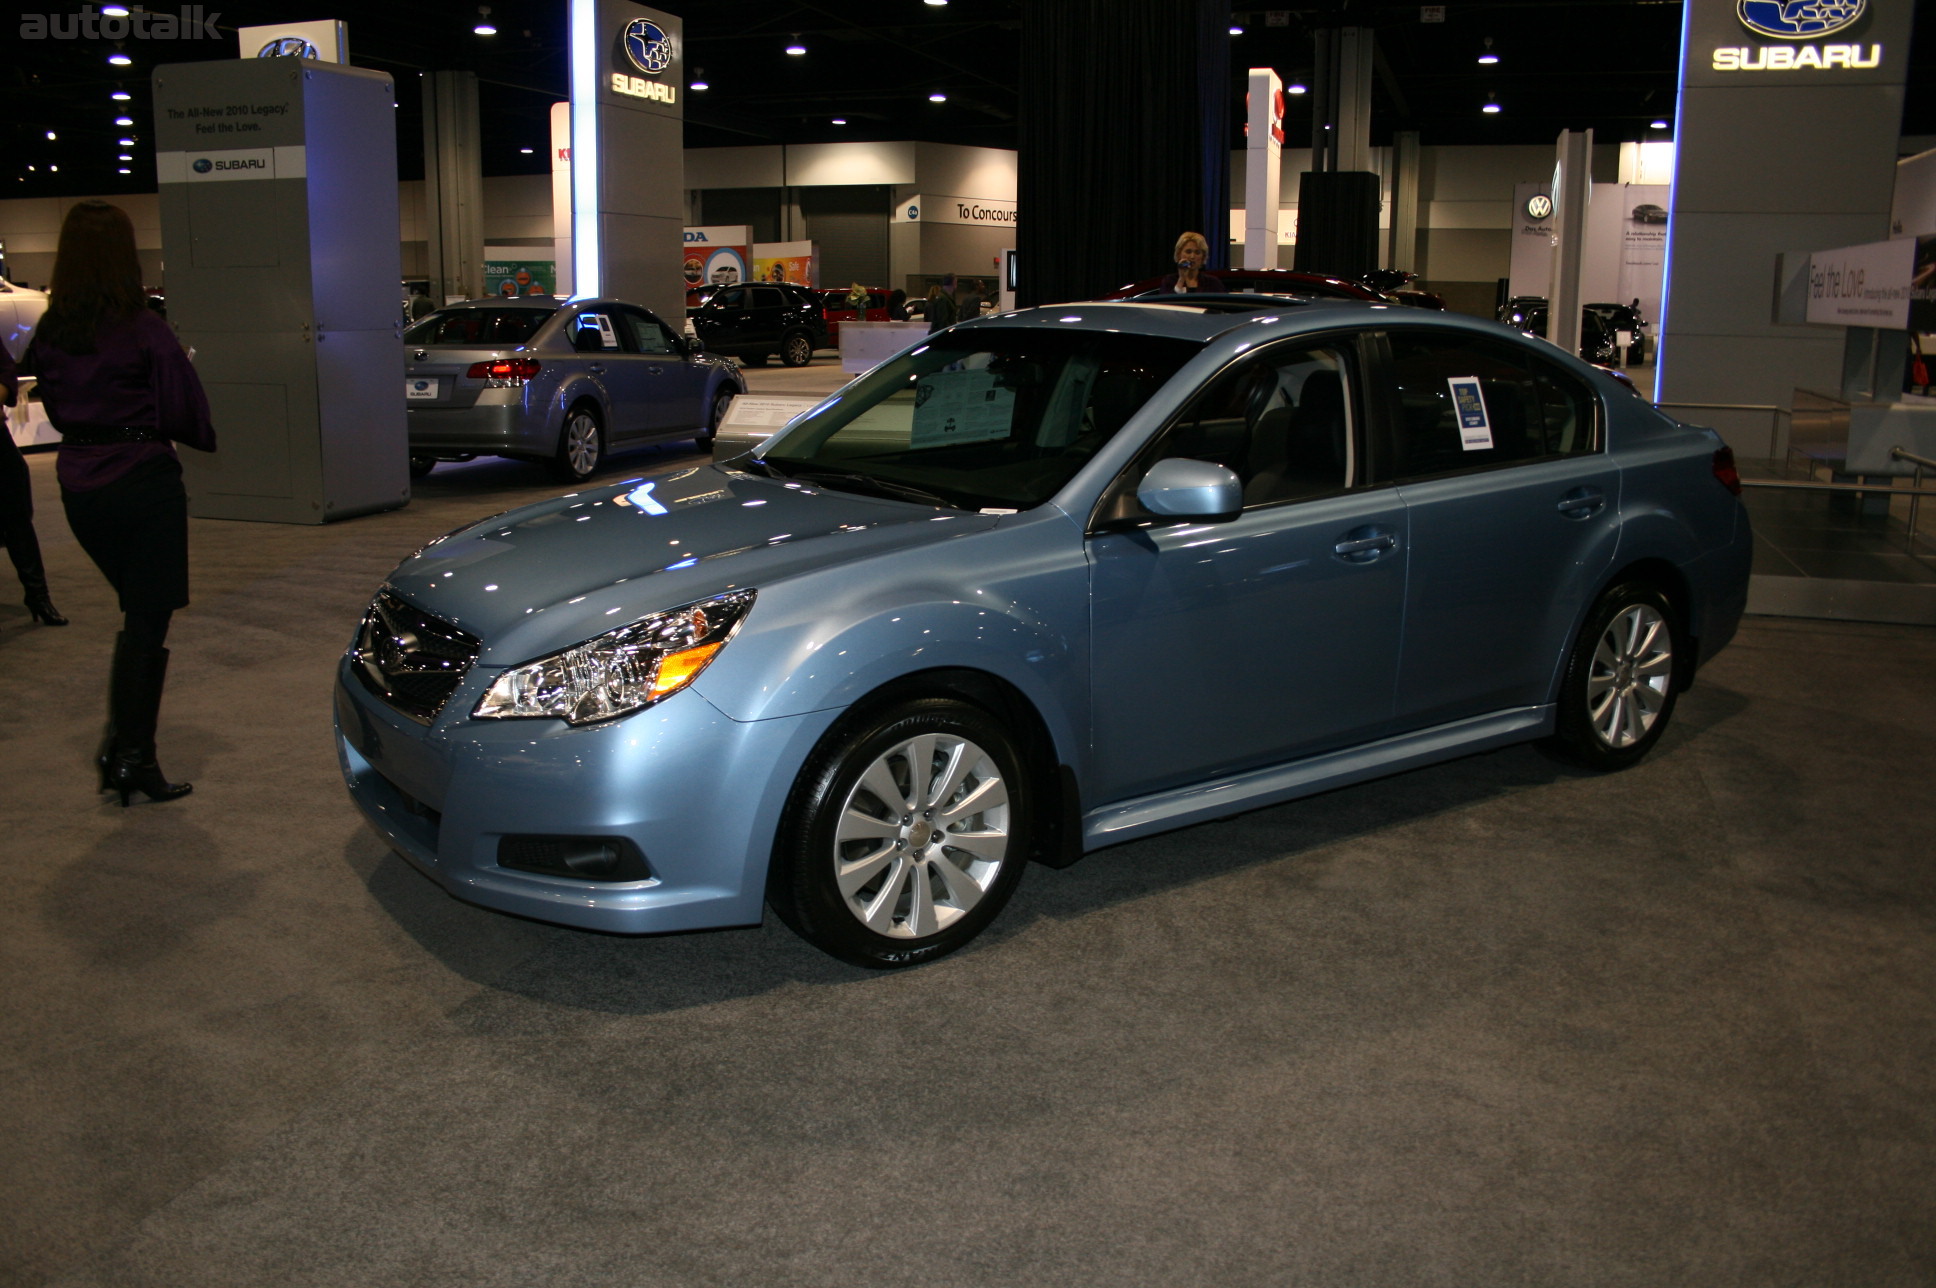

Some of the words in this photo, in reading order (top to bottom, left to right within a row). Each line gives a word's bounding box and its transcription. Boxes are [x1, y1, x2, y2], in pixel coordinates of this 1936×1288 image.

[1712, 44, 1881, 71] SUBARU
[612, 73, 676, 104] SUBARU
[168, 109, 185, 119] The
[187, 107, 223, 118] All-New
[226, 105, 248, 116] 2010
[195, 123, 216, 134] Feel
[218, 123, 233, 133] the
[236, 122, 262, 132] Love.
[215, 159, 265, 170] SUBARU
[957, 203, 970, 219] To
[1809, 264, 1826, 298] Feel
[1826, 263, 1841, 298] the
[1841, 262, 1864, 298] Love
